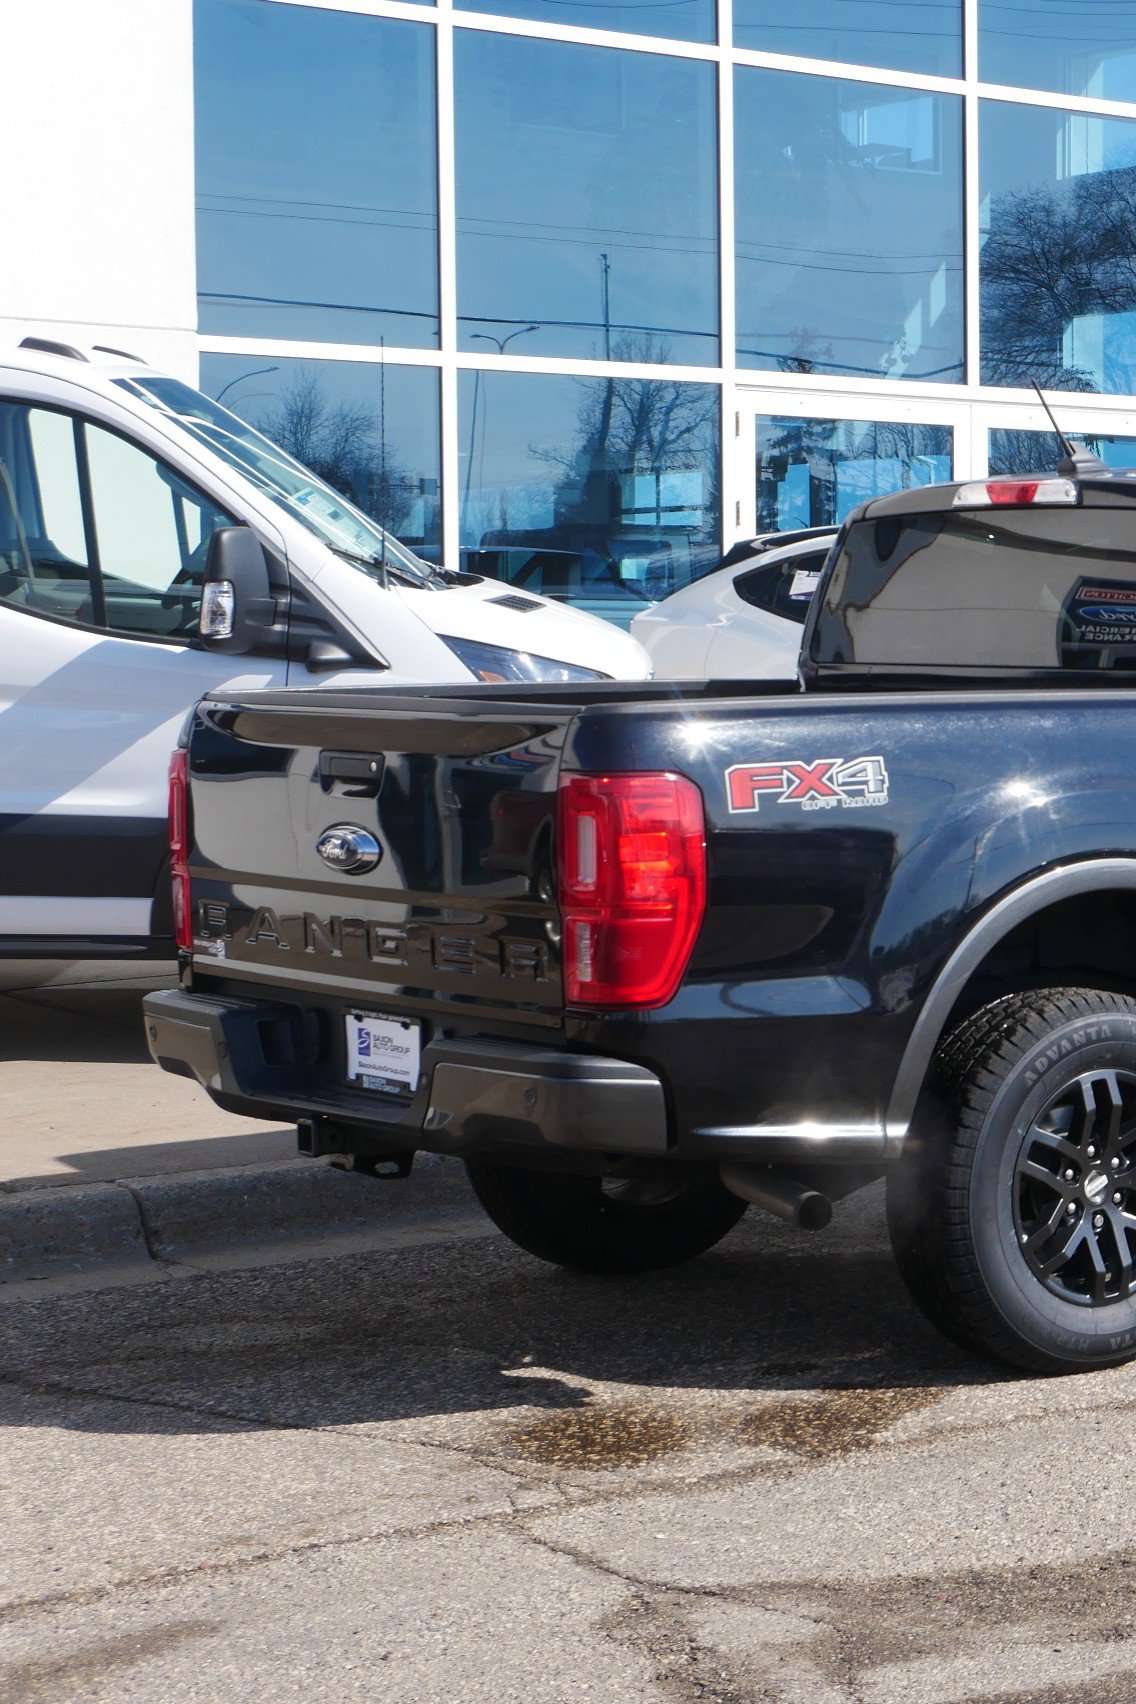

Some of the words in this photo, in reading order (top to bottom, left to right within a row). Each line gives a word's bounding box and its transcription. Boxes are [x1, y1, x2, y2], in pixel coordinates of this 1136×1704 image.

[724, 756, 889, 814] FX4
[801, 799, 838, 811] OFF
[842, 796, 889, 808] ROAD
[199, 899, 550, 983] RANGER
[372, 1034, 394, 1044] SAXON
[372, 1042, 389, 1051] AUTO
[389, 1044, 411, 1055] GROUP
[1024, 1025, 1112, 1087] ADVANTA
